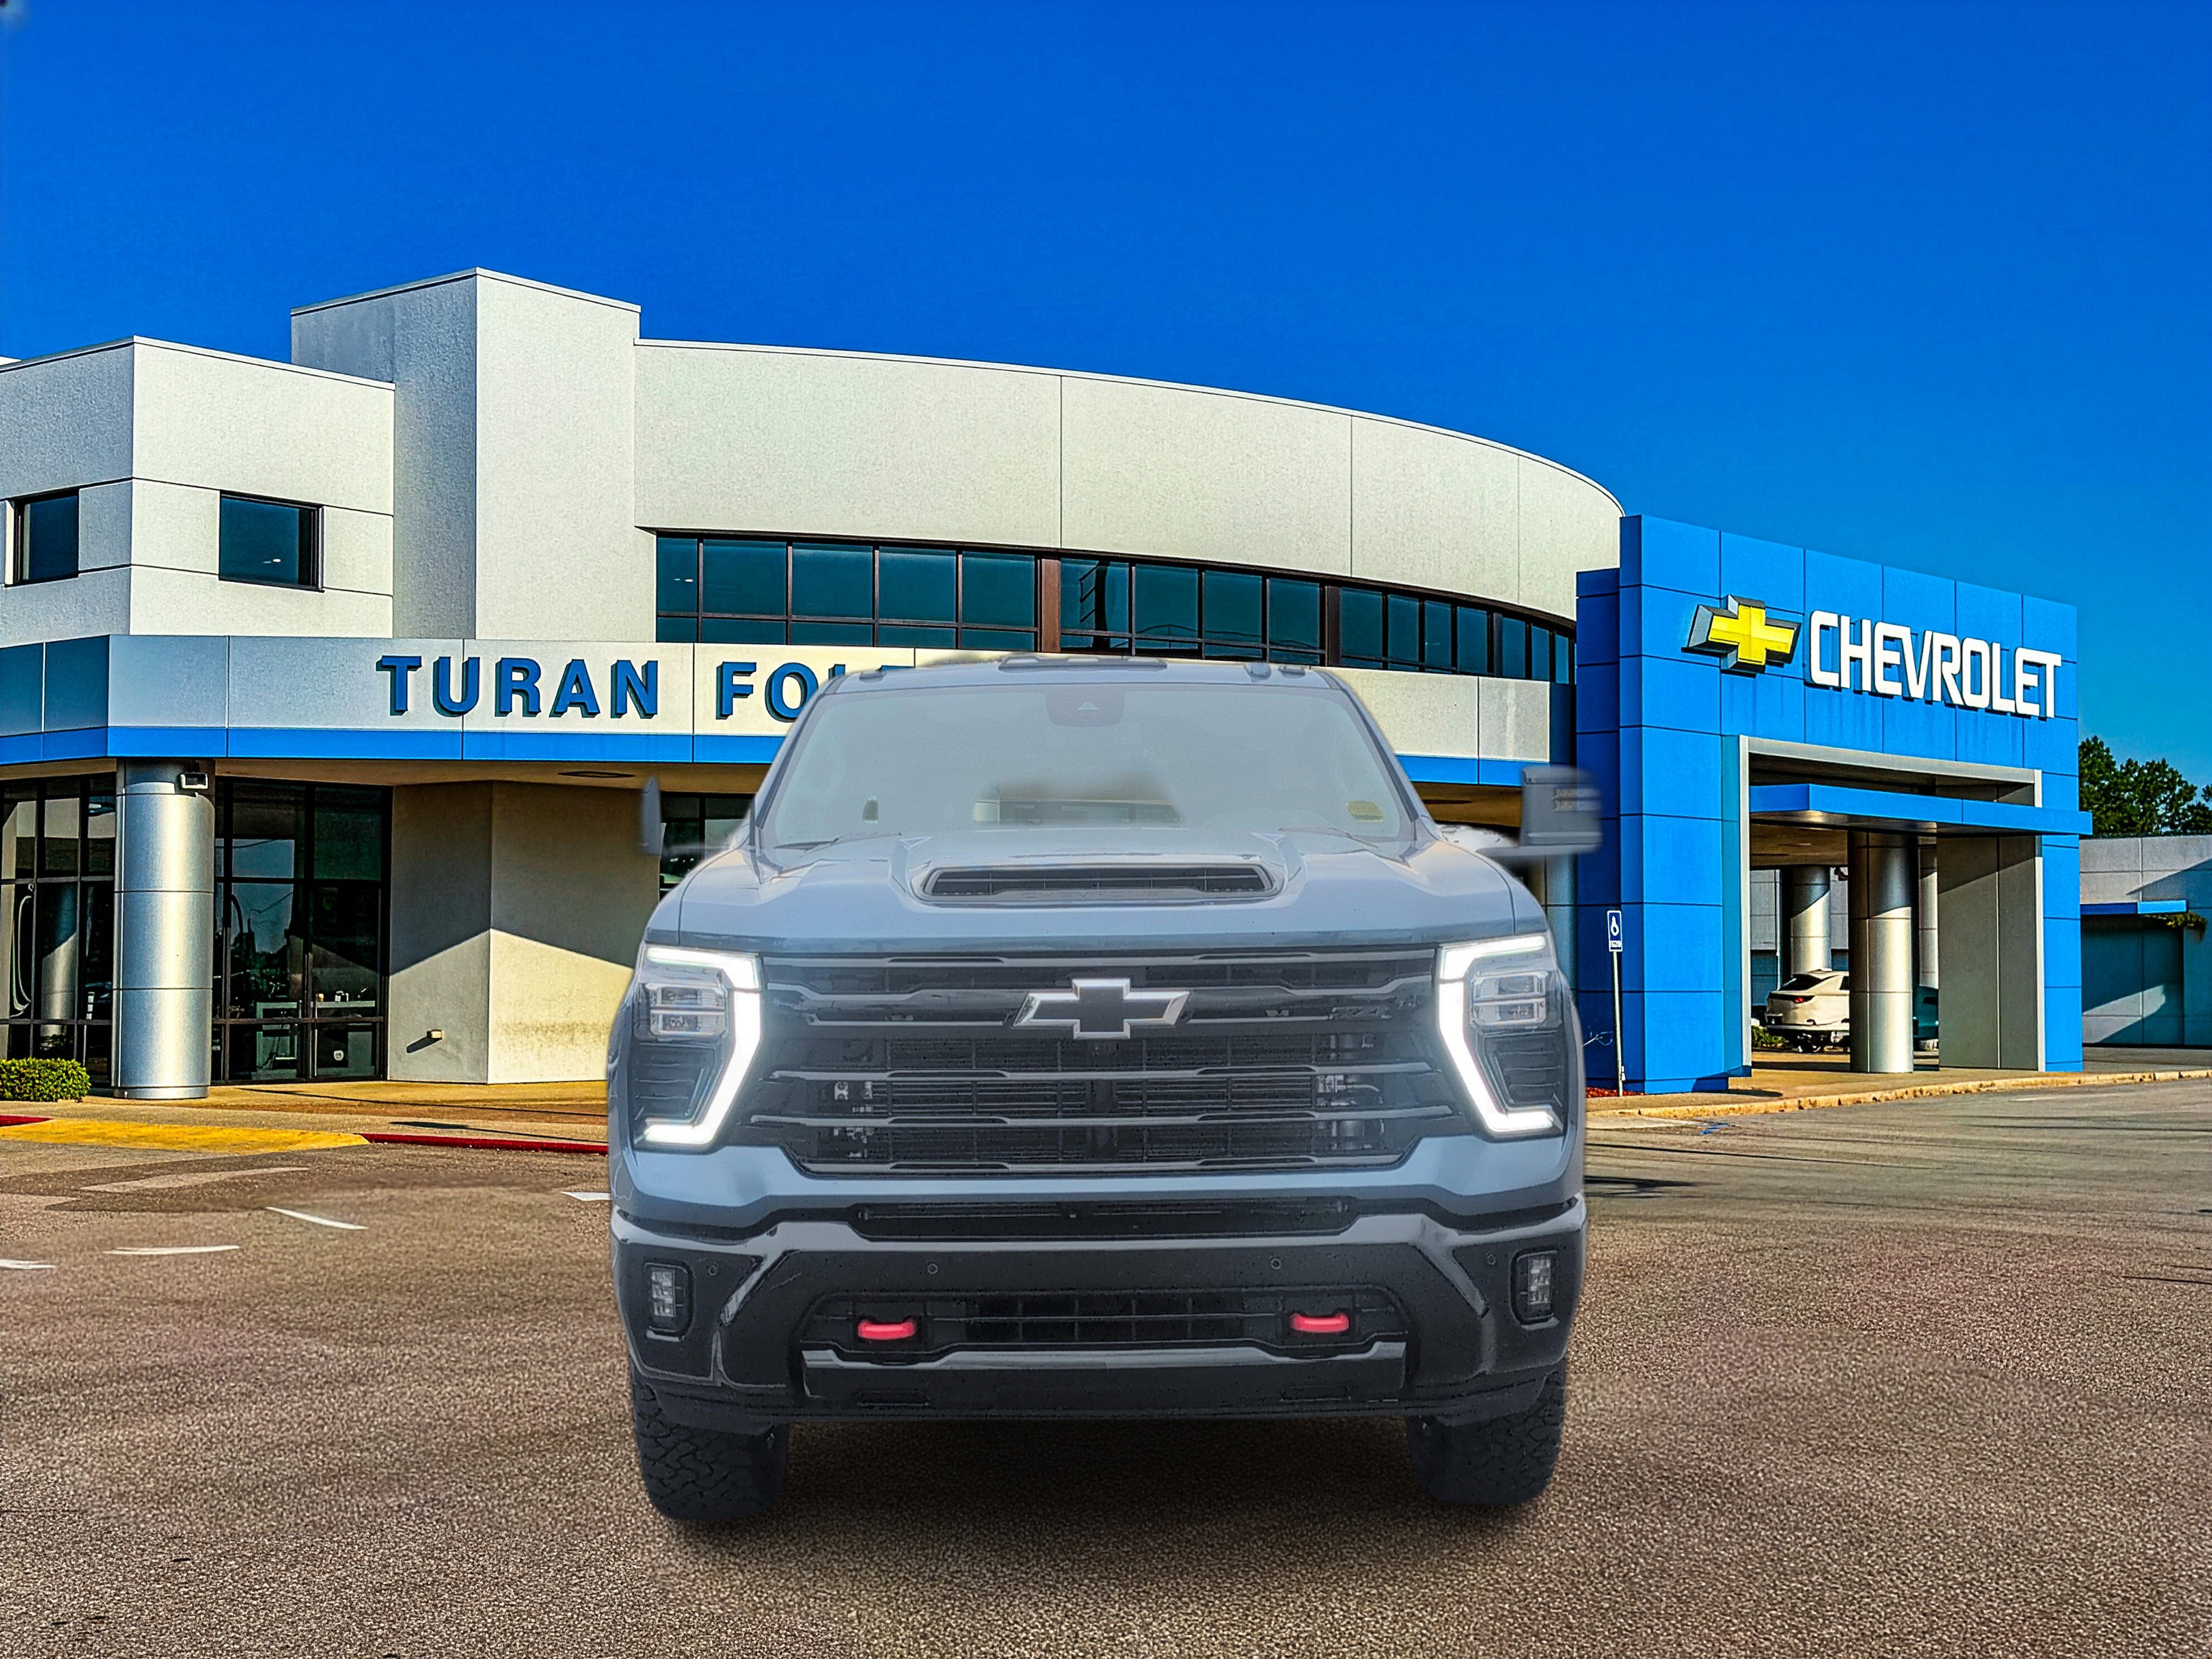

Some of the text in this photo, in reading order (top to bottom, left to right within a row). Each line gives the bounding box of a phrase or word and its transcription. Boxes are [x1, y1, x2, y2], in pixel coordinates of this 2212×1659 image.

[376, 655, 915, 723] TURAN FO
[1809, 610, 2062, 718] CHEVROLET
